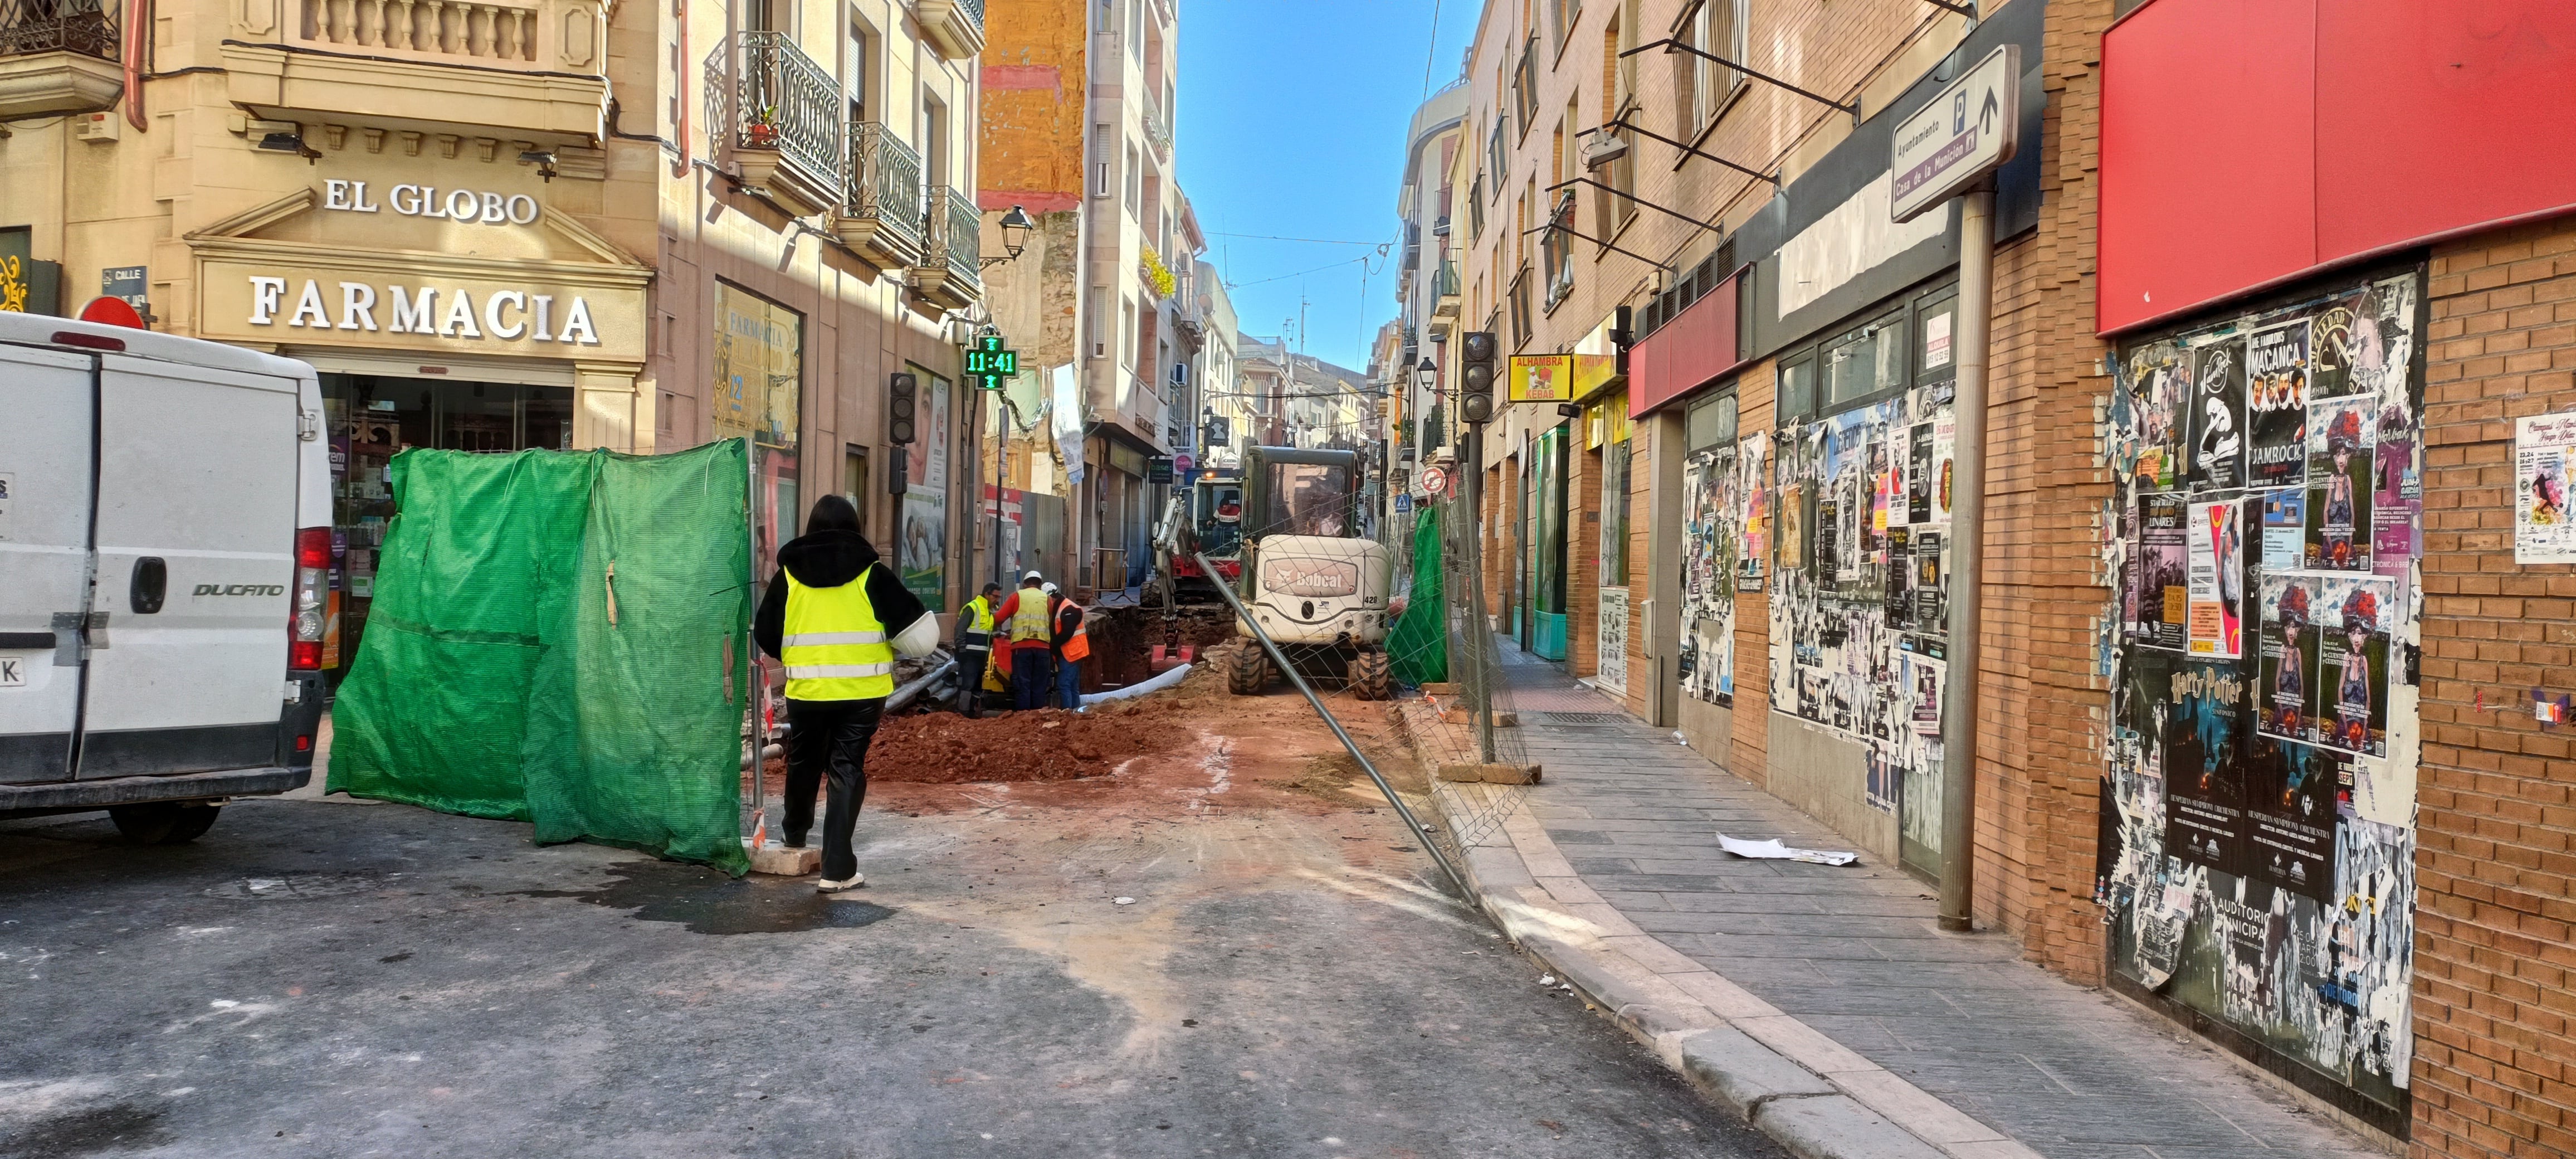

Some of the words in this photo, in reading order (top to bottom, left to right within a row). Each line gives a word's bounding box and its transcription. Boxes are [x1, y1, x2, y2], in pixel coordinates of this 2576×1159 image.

[1898, 120, 1939, 159] Ayuntamiento
[1896, 179, 1910, 197] Casa
[1913, 171, 1921, 186] de
[1924, 164, 1931, 178] la
[1934, 143, 1964, 172] Munición
[324, 179, 378, 212] EL
[389, 184, 538, 224] GLOBO
[115, 270, 142, 280] CALLE
[248, 276, 598, 344] FARMACIA
[730, 312, 783, 348] FARMACIA
[968, 353, 1013, 372] 11:41
[1516, 357, 1563, 367] ALHAMBRA
[2250, 342, 2301, 374] MACANCA
[1525, 389, 1554, 400] KEBAB
[2149, 517, 2174, 527] LINARES
[1296, 571, 1342, 588] Bobcat
[192, 584, 285, 596] DUCATO
[2325, 659, 2350, 667] CUENTISTAS
[2328, 652, 2353, 661] CUENTEROS
[2171, 671, 2204, 705] Harry
[2206, 666, 2243, 709] Potter
[2248, 809, 2273, 824] HESPERIAN
[2273, 817, 2299, 831] SYMPHONY
[2299, 824, 2330, 840] ORCHESTRA
